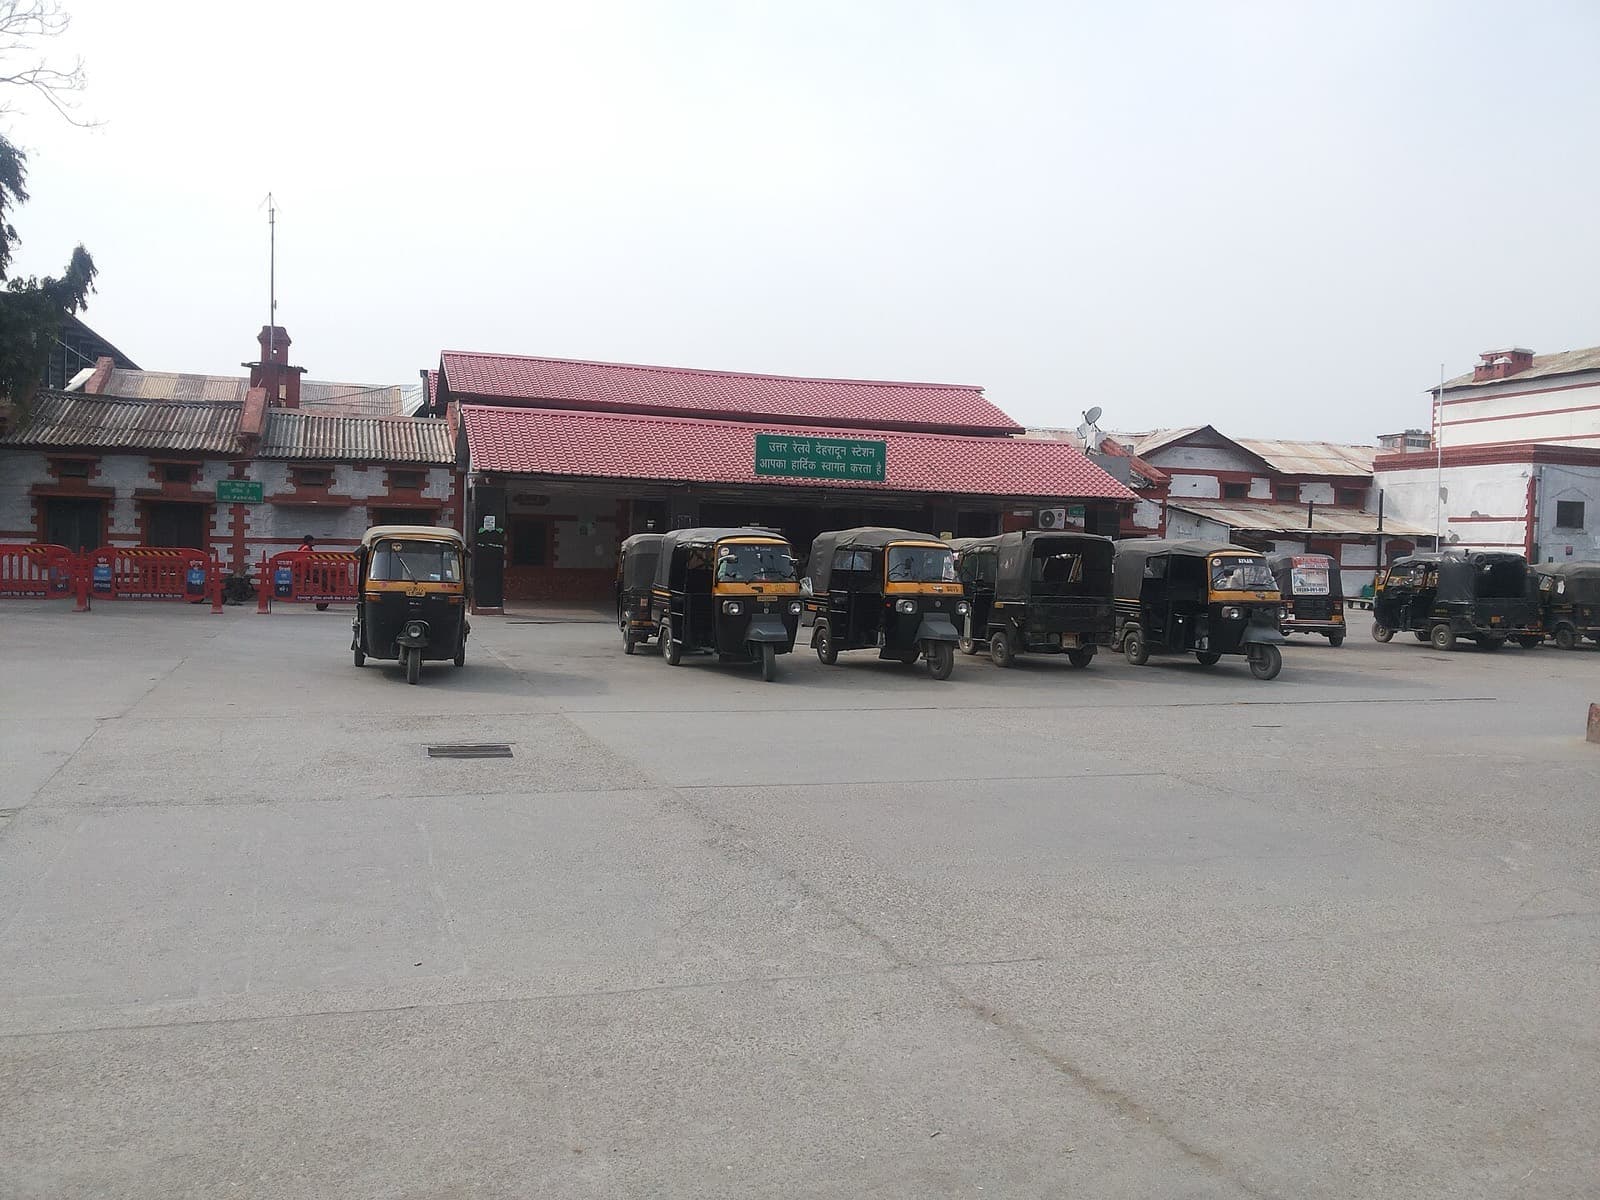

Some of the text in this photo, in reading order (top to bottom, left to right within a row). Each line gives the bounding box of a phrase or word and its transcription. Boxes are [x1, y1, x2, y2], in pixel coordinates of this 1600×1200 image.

[769, 440, 874, 459] उत्तर रेलवे देहरादून स्टेशन
[759, 457, 882, 475] आपका हार्दिक स्वागत करता है
